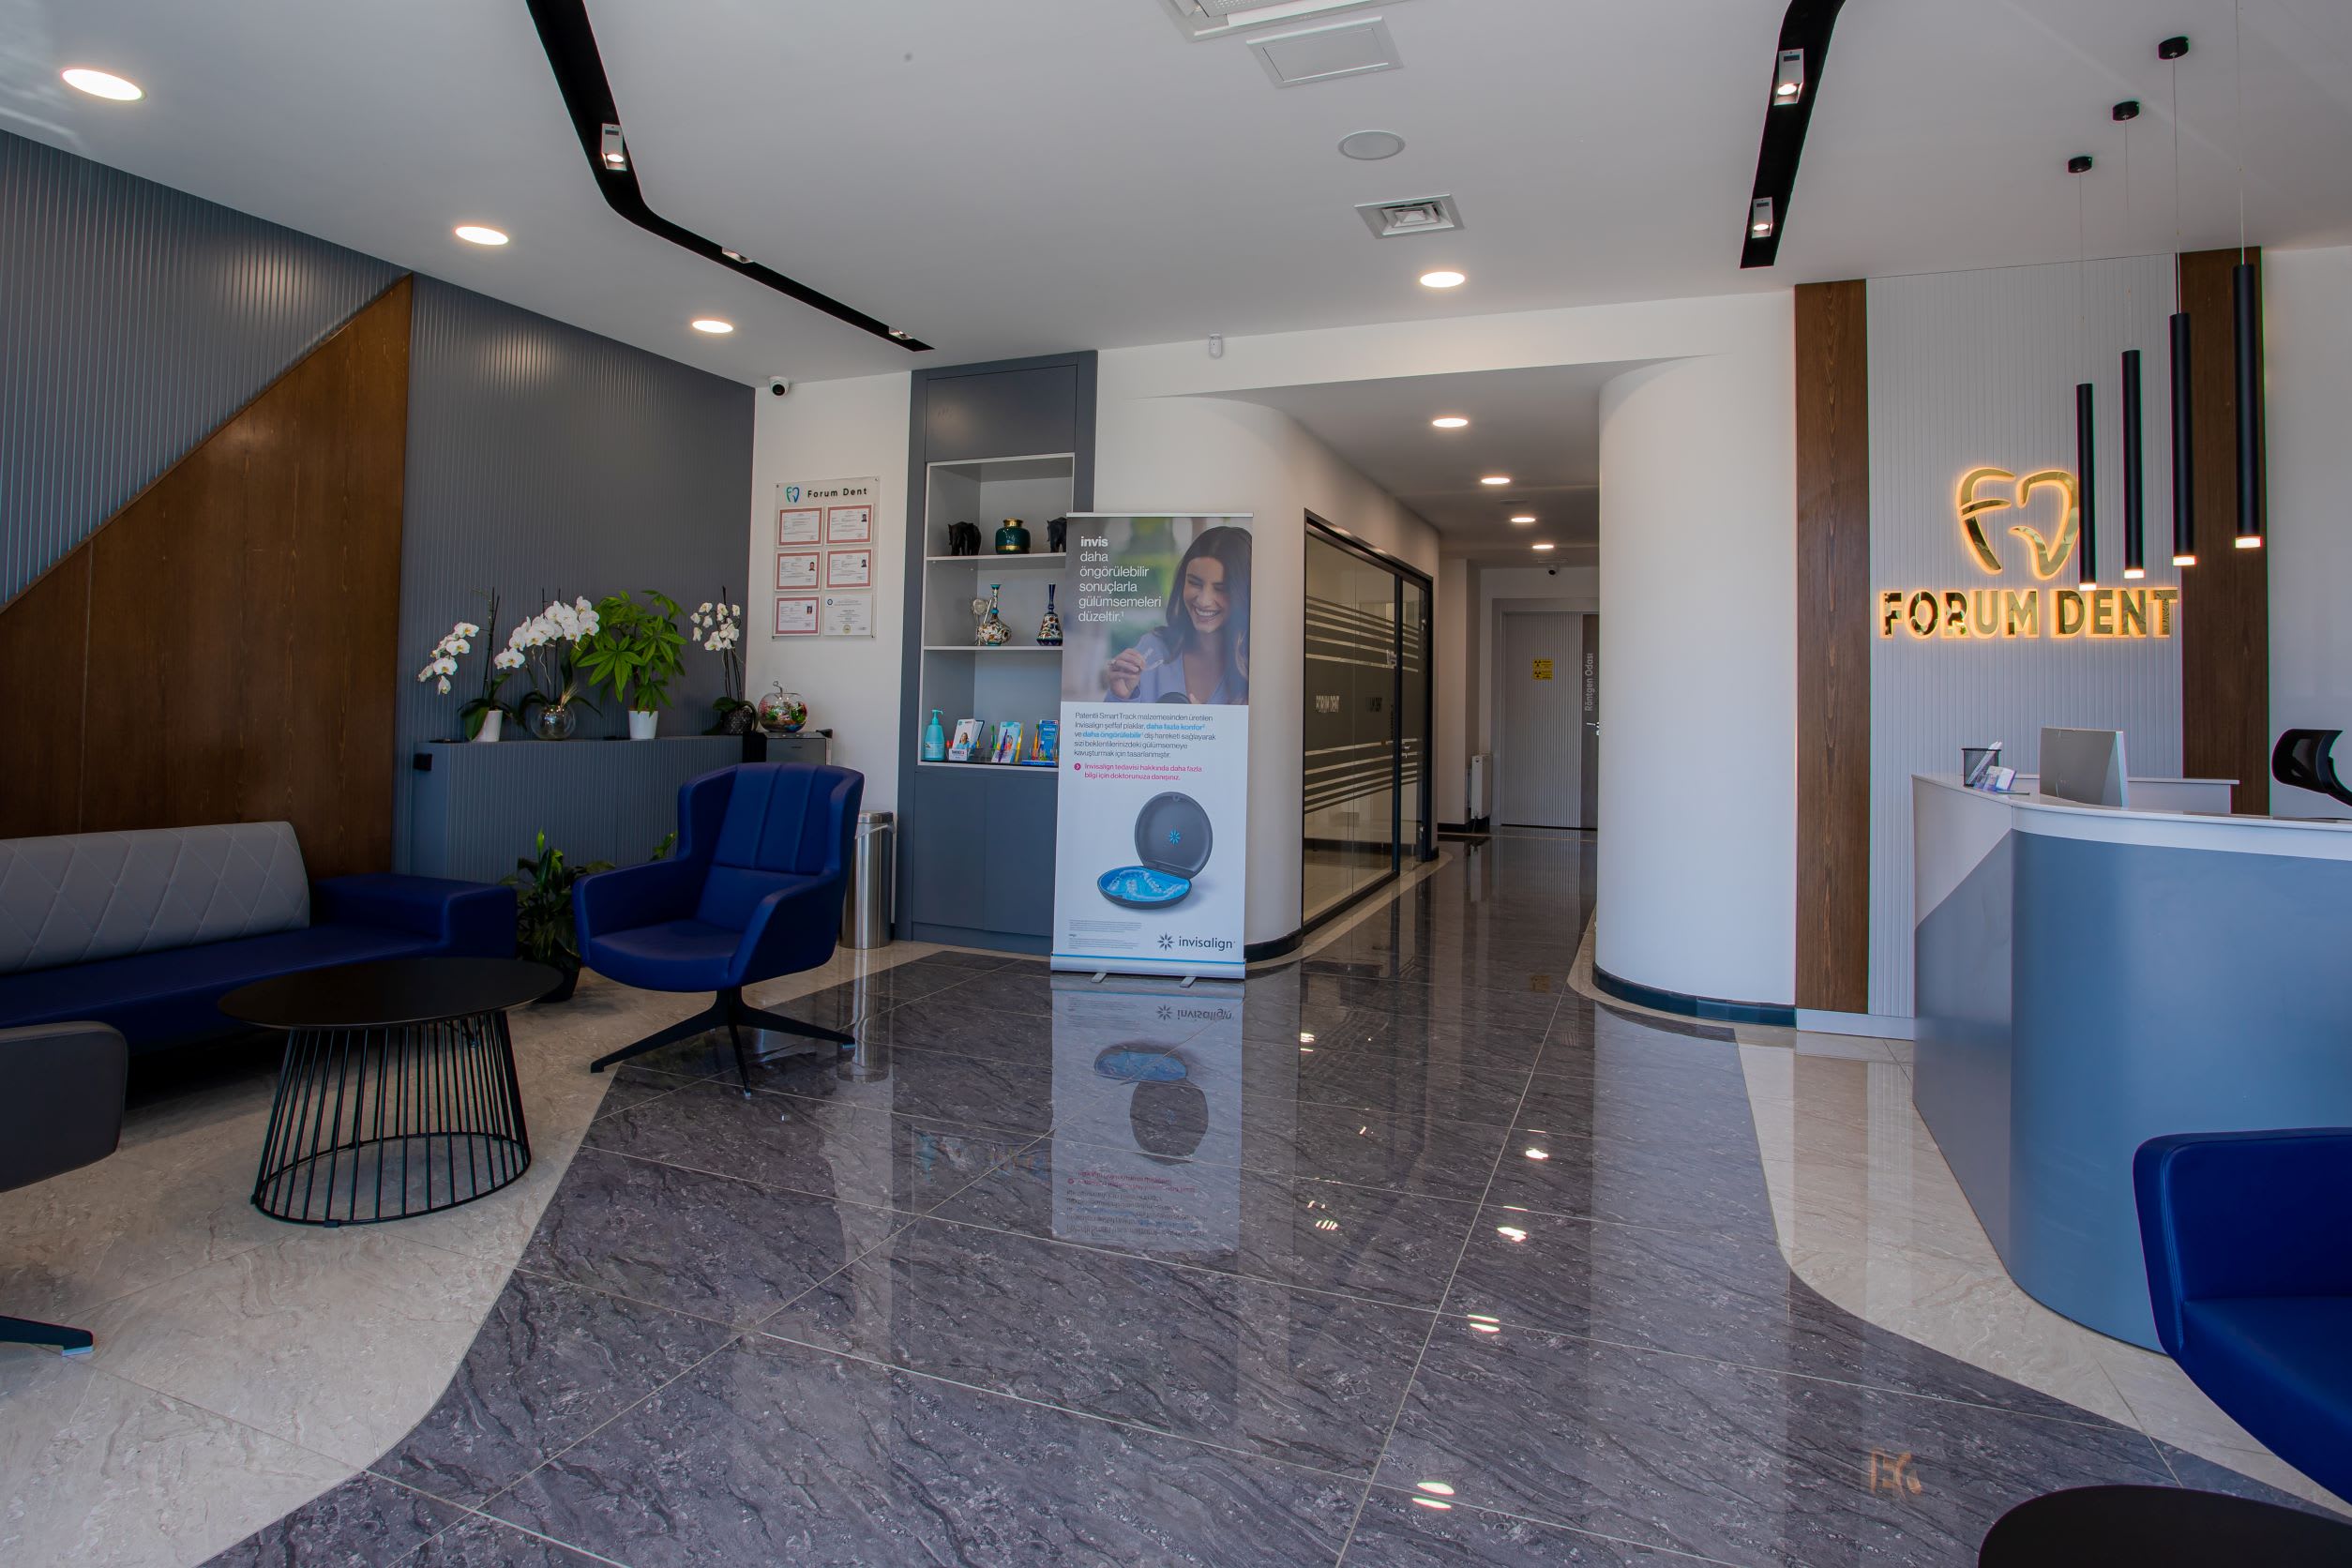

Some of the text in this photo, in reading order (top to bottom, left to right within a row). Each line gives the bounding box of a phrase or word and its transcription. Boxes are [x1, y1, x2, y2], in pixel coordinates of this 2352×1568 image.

[807, 487, 867, 498] Forum Dent
[1080, 536, 1108, 547] invis
[1080, 551, 1108, 562] daha
[1079, 566, 1149, 579] öngörülebilir
[1079, 581, 1138, 594] sonuçlarla
[1078, 596, 1162, 610] gülümsemeleri
[1880, 588, 2179, 639] FORUM DENT
[1075, 722, 1104, 730] Invisalign
[1178, 936, 1233, 951] invisalign
